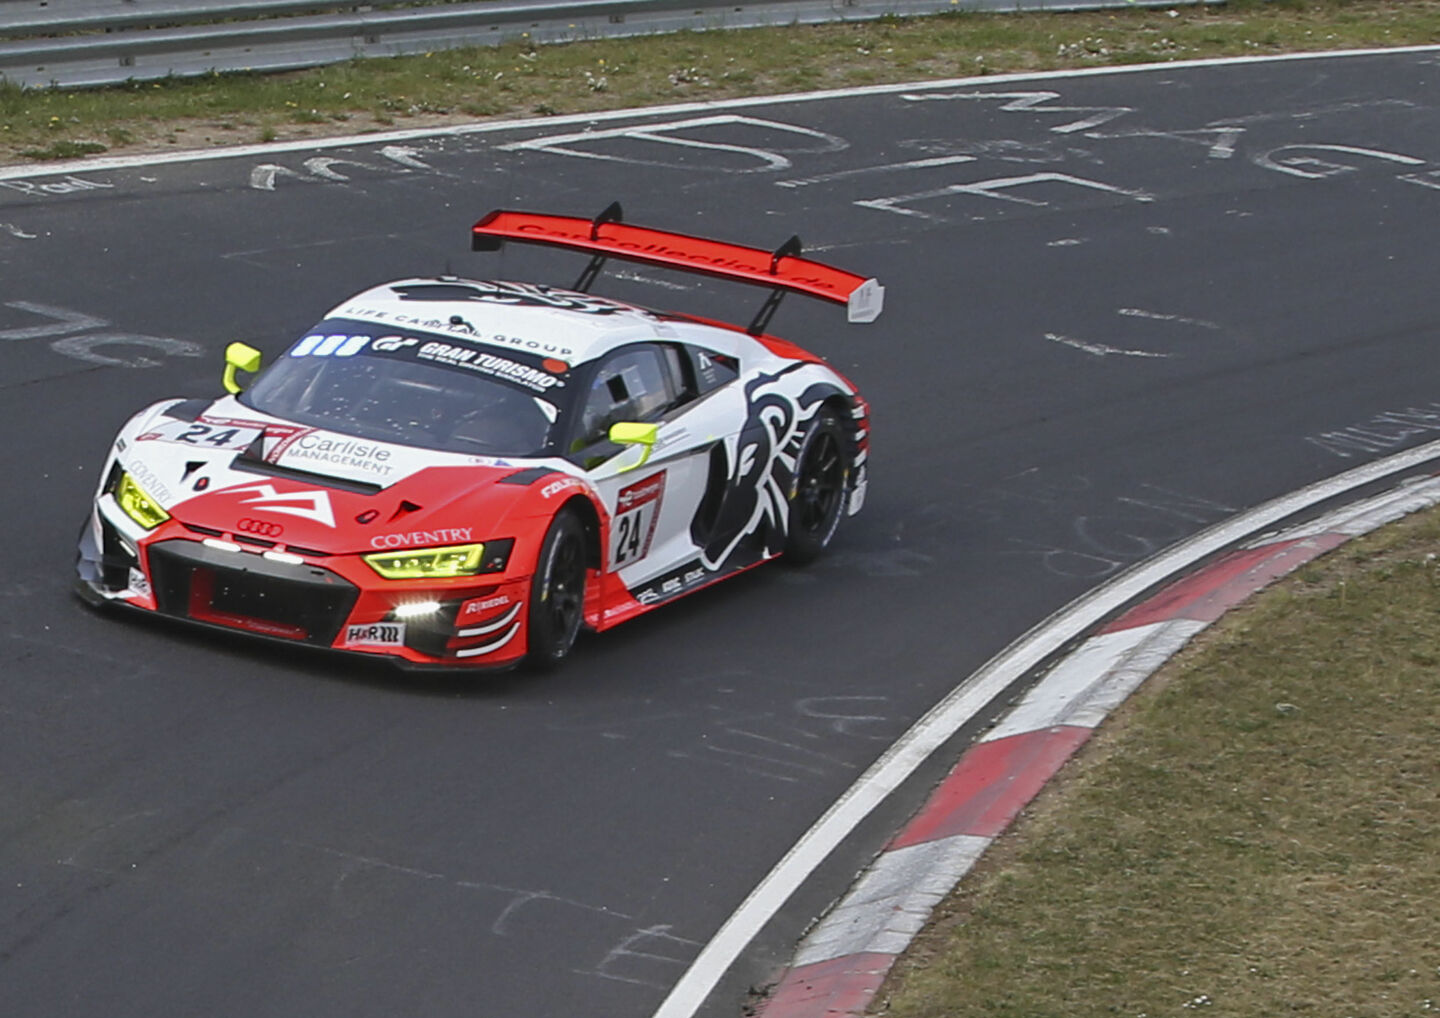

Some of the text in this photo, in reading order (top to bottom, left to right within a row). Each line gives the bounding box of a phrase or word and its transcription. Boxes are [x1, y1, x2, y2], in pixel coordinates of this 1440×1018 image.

[419, 341, 473, 365] GRAN
[494, 333, 573, 357] GROUP
[175, 424, 241, 446] 24
[300, 434, 393, 462] Carlisle
[287, 448, 394, 476] MANAGEMENT
[128, 460, 173, 503] COVENTRY
[370, 527, 473, 549] COVENTRY
[615, 510, 643, 564] 24
